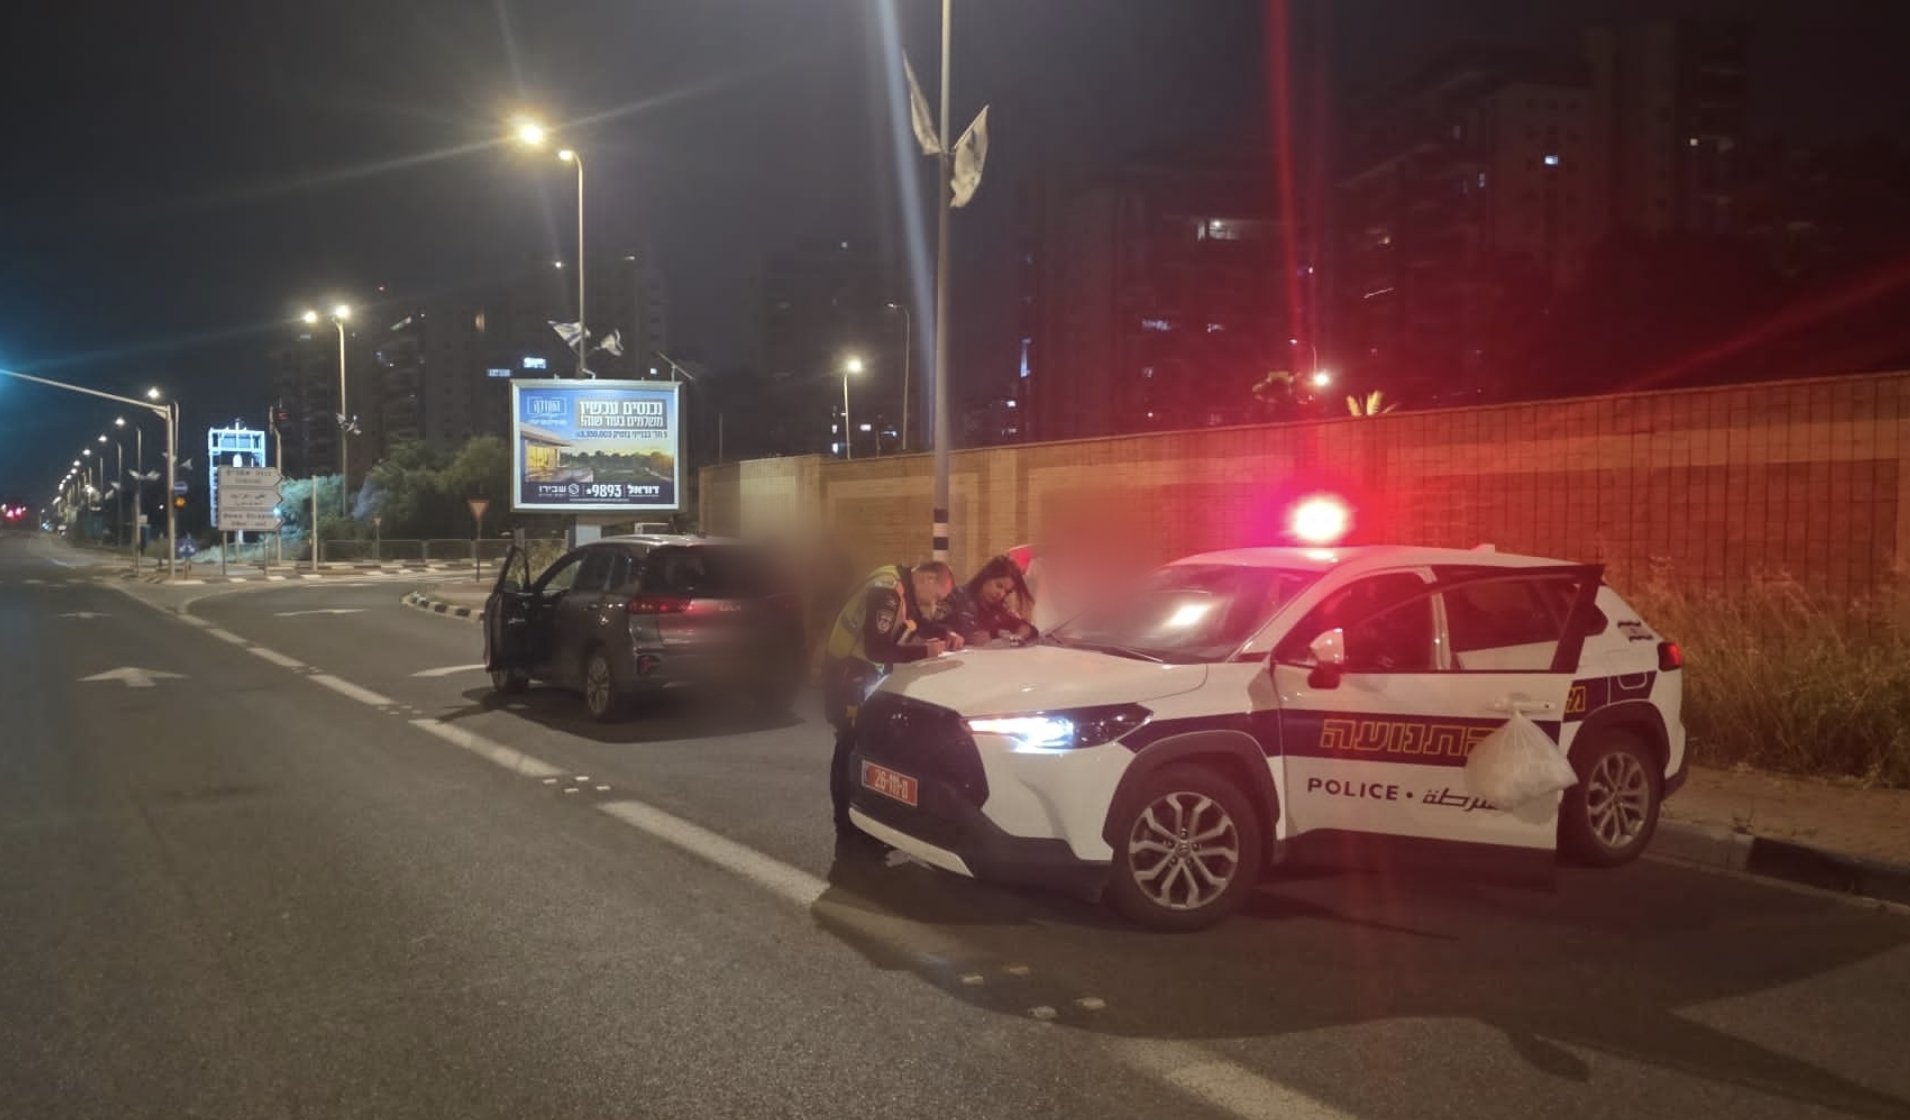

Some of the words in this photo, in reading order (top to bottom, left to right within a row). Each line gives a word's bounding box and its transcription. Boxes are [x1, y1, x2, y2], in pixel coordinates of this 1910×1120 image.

[623, 401, 663, 415] נכנסים
[627, 415, 663, 427] משלמים
[1307, 777, 1400, 801] POLICE
